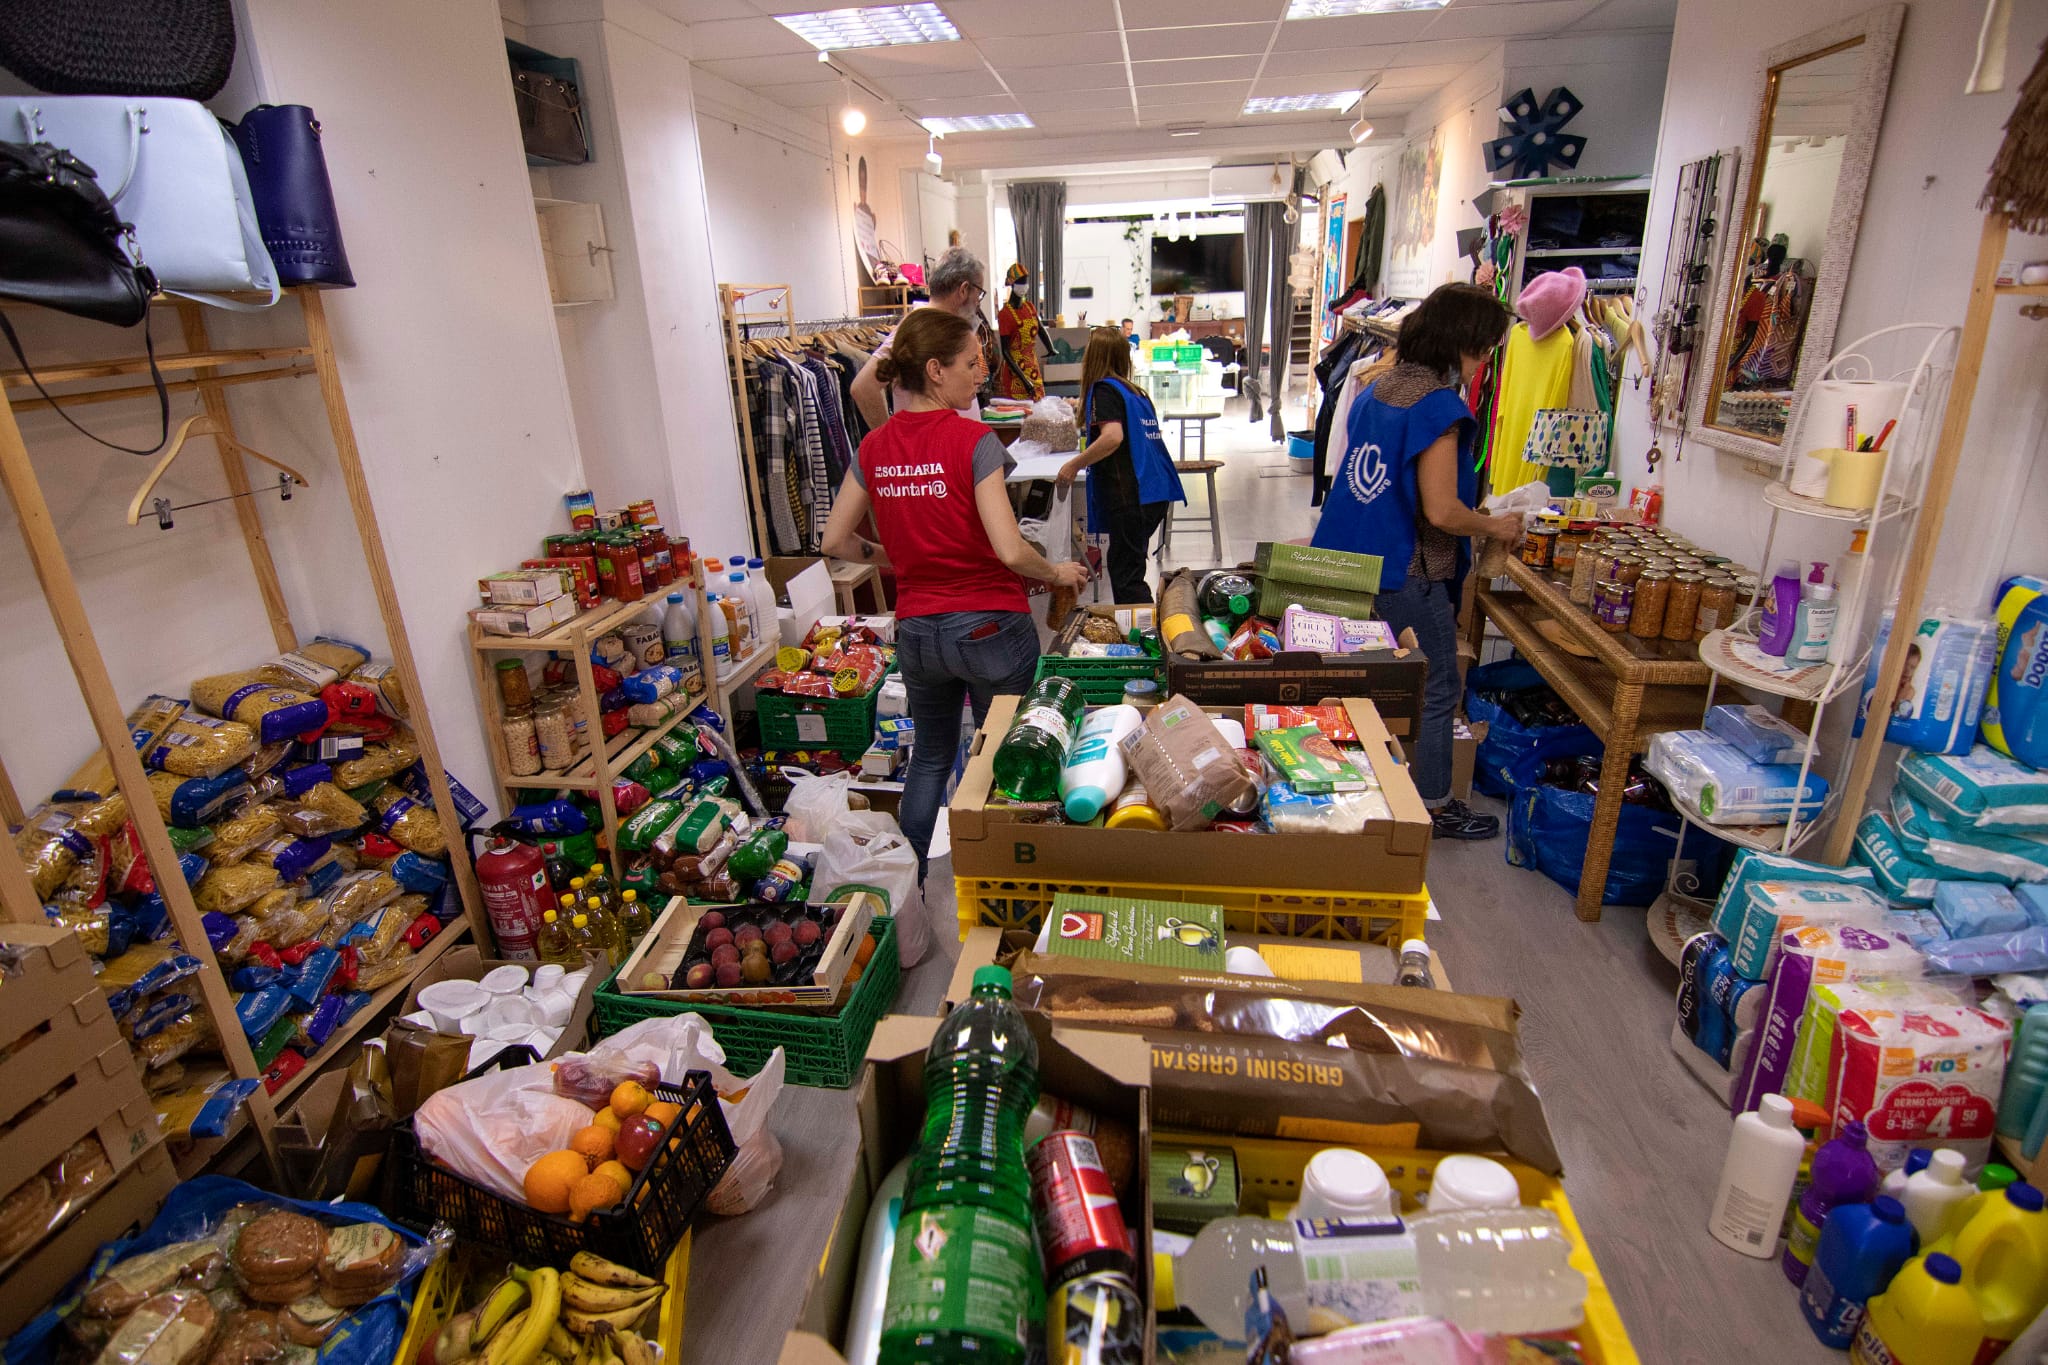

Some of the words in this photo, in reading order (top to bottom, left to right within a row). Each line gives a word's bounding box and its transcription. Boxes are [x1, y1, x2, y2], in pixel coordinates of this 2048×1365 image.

[1014, 842, 1037, 864] B
[1151, 1048, 1237, 1076] CRISTAL
[1246, 1058, 1344, 1087] GRISSINI
[1918, 1057, 1968, 1073] KIDS
[1894, 1096, 1926, 1107] DERMO
[1926, 1096, 1967, 1107] CONFORT
[1886, 1118, 1914, 1130] 9-15
[1887, 1109, 1926, 1119] TALLA
[1925, 1106, 1953, 1138] 4
